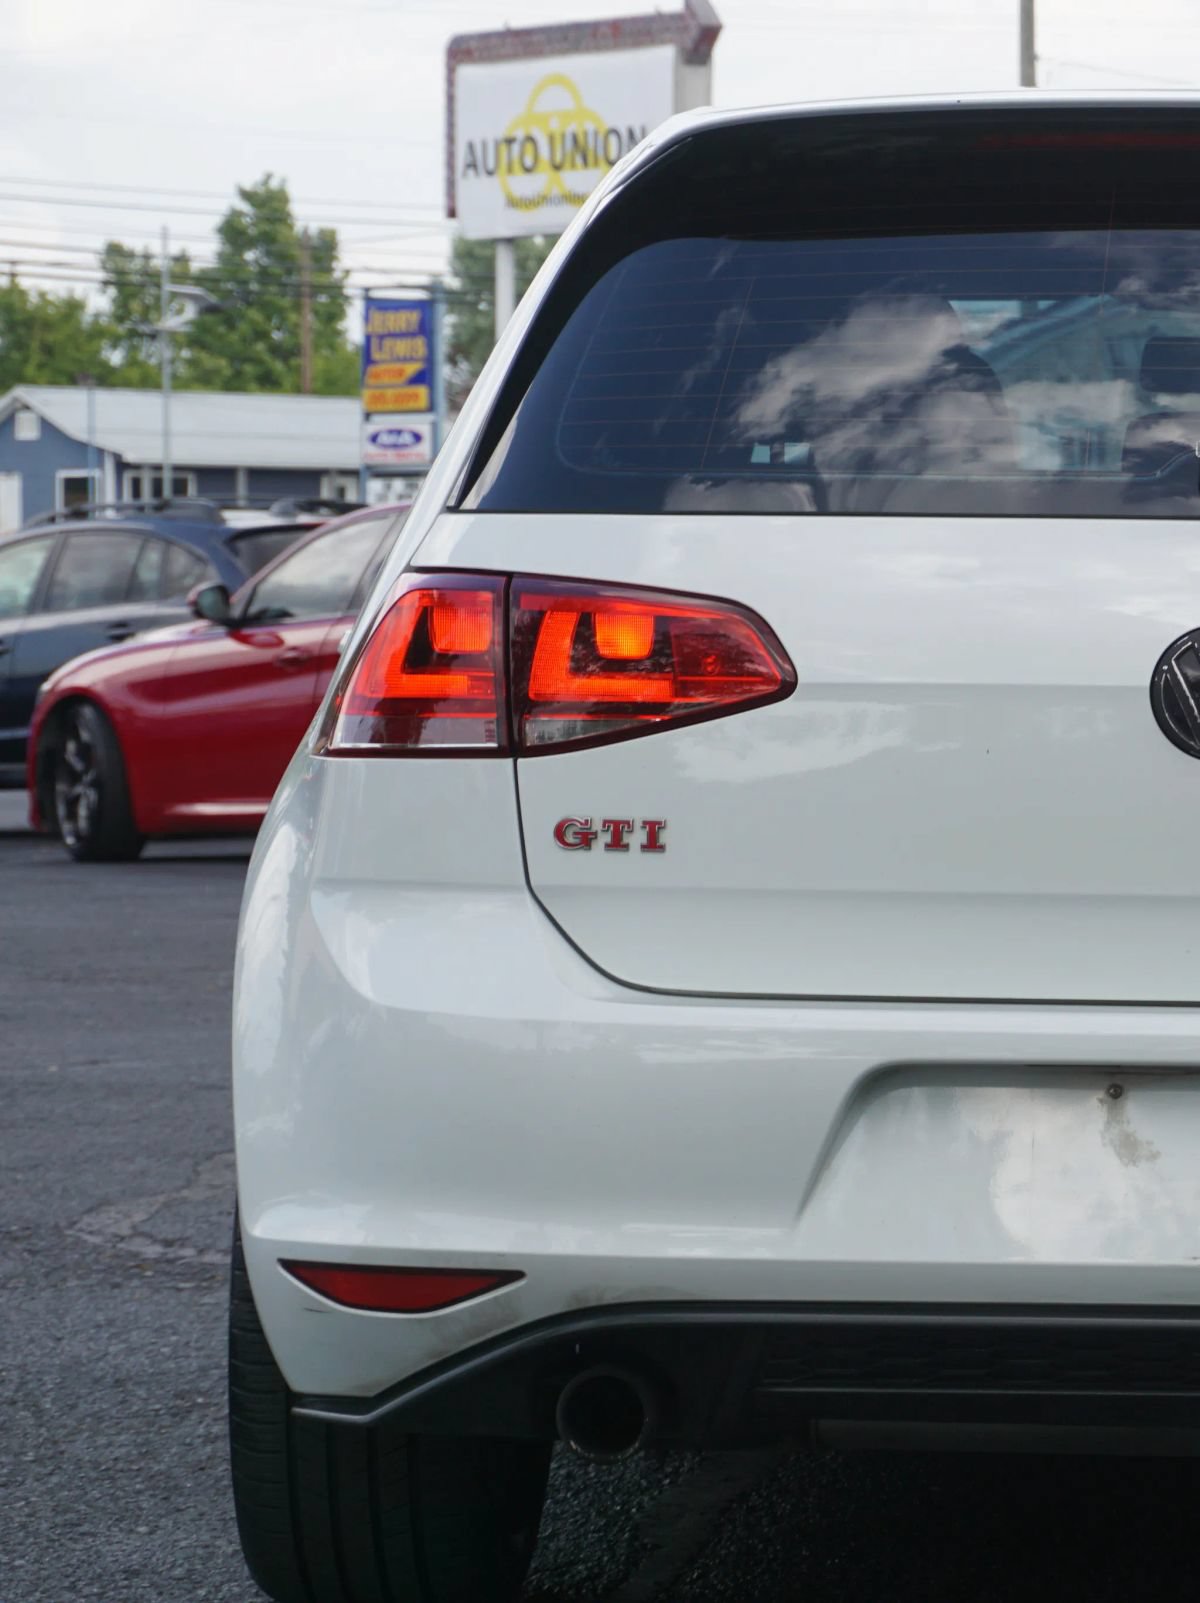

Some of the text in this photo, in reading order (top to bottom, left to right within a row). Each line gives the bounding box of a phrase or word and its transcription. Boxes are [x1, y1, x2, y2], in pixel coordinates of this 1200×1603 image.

[462, 125, 648, 178] AUTO UNION
[367, 308, 421, 334] JERRY
[553, 816, 667, 852] GTI
